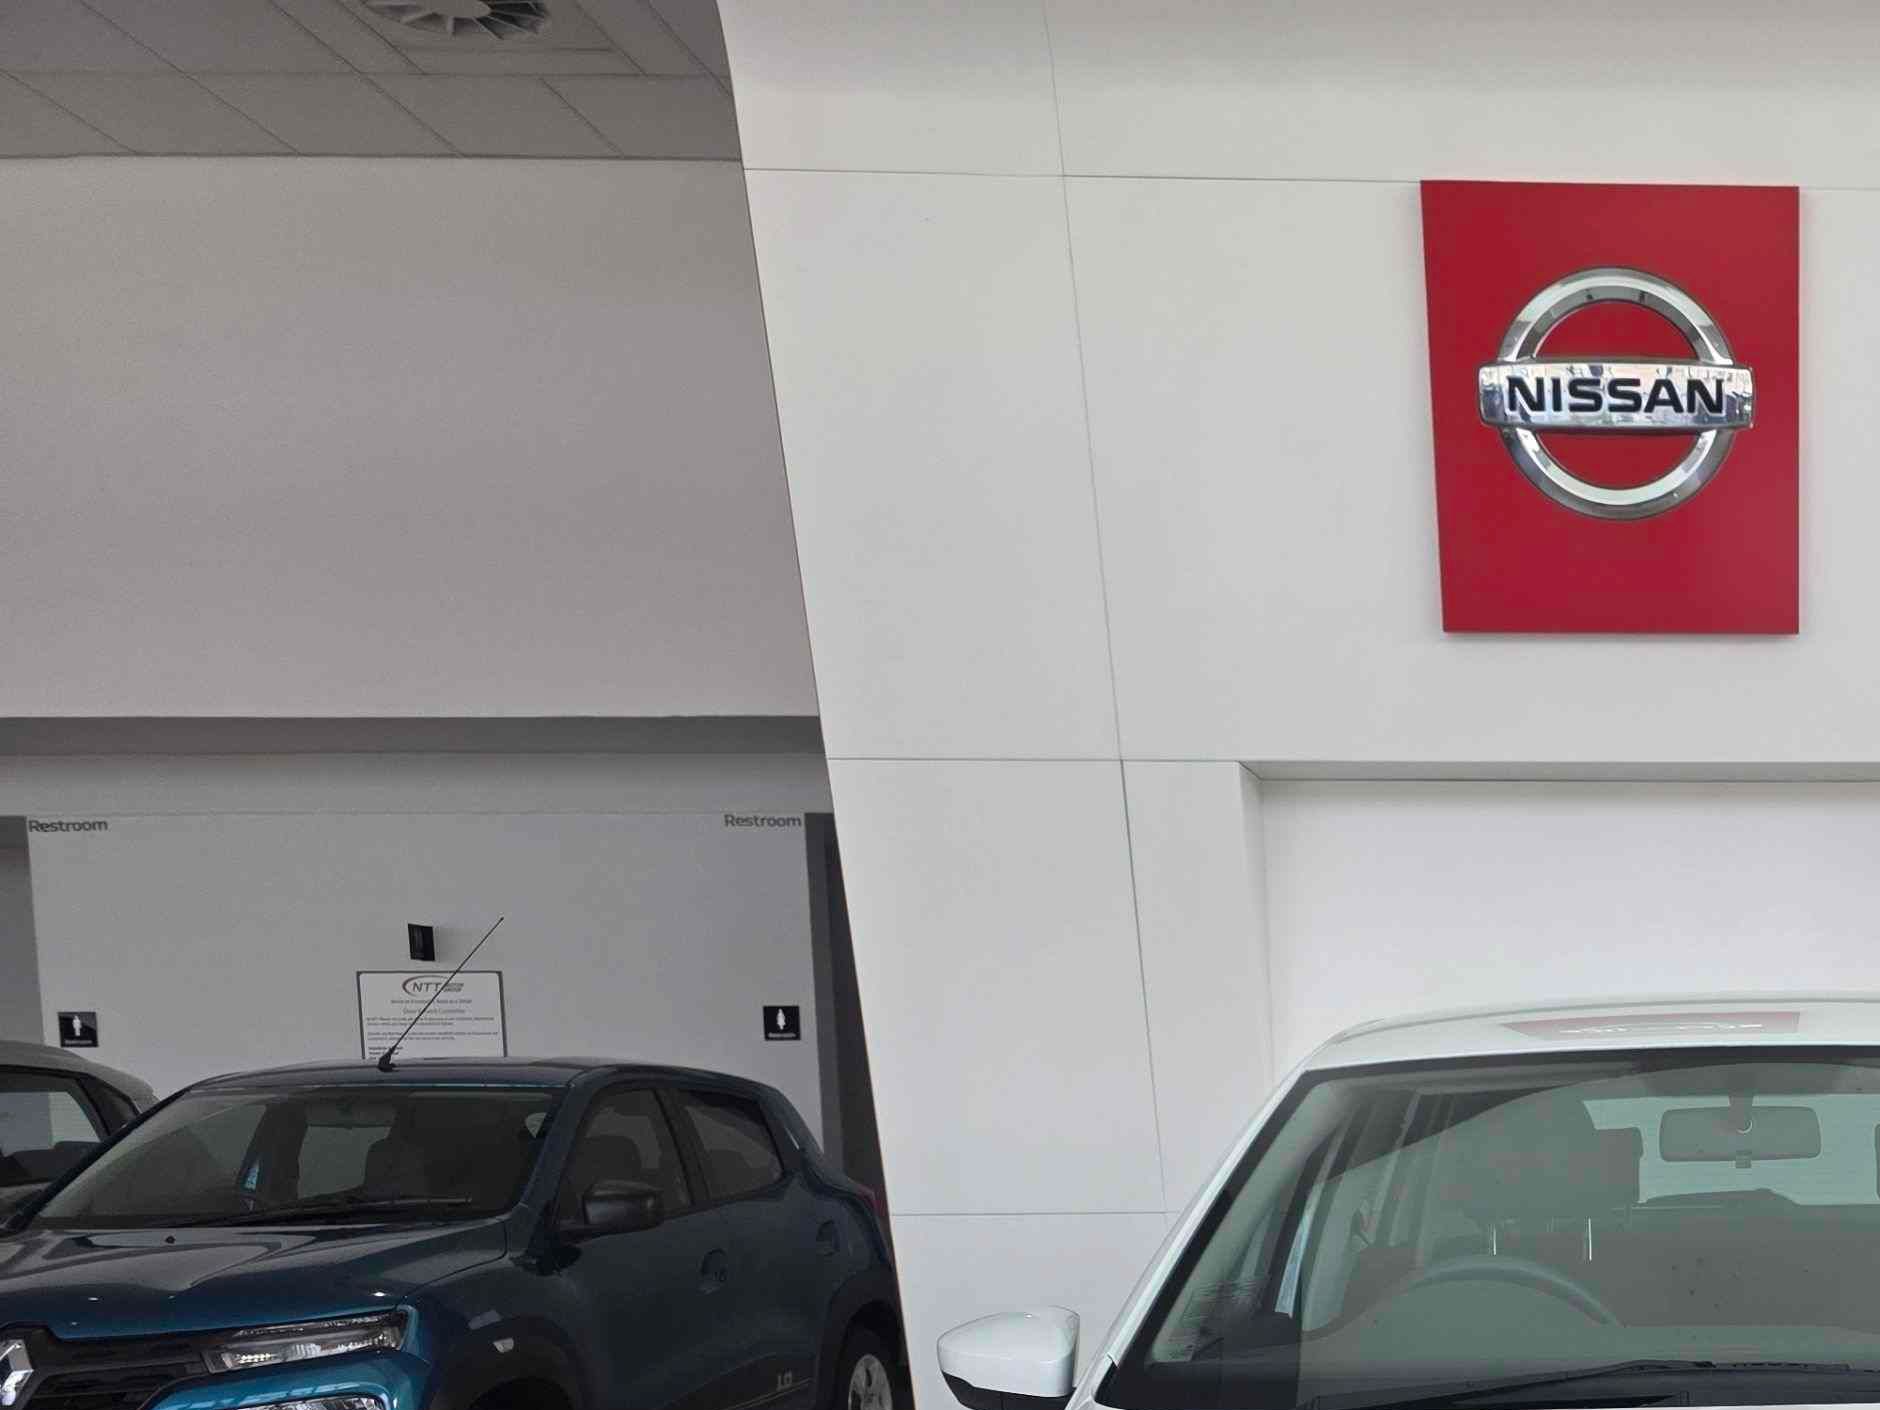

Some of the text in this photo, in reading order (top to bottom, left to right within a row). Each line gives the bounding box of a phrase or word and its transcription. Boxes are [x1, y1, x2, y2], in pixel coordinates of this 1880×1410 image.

[1506, 376, 1724, 414] NISSAN
[28, 820, 108, 832] Restroom
[724, 814, 802, 827] Restroom
[412, 982, 443, 993] NTT
